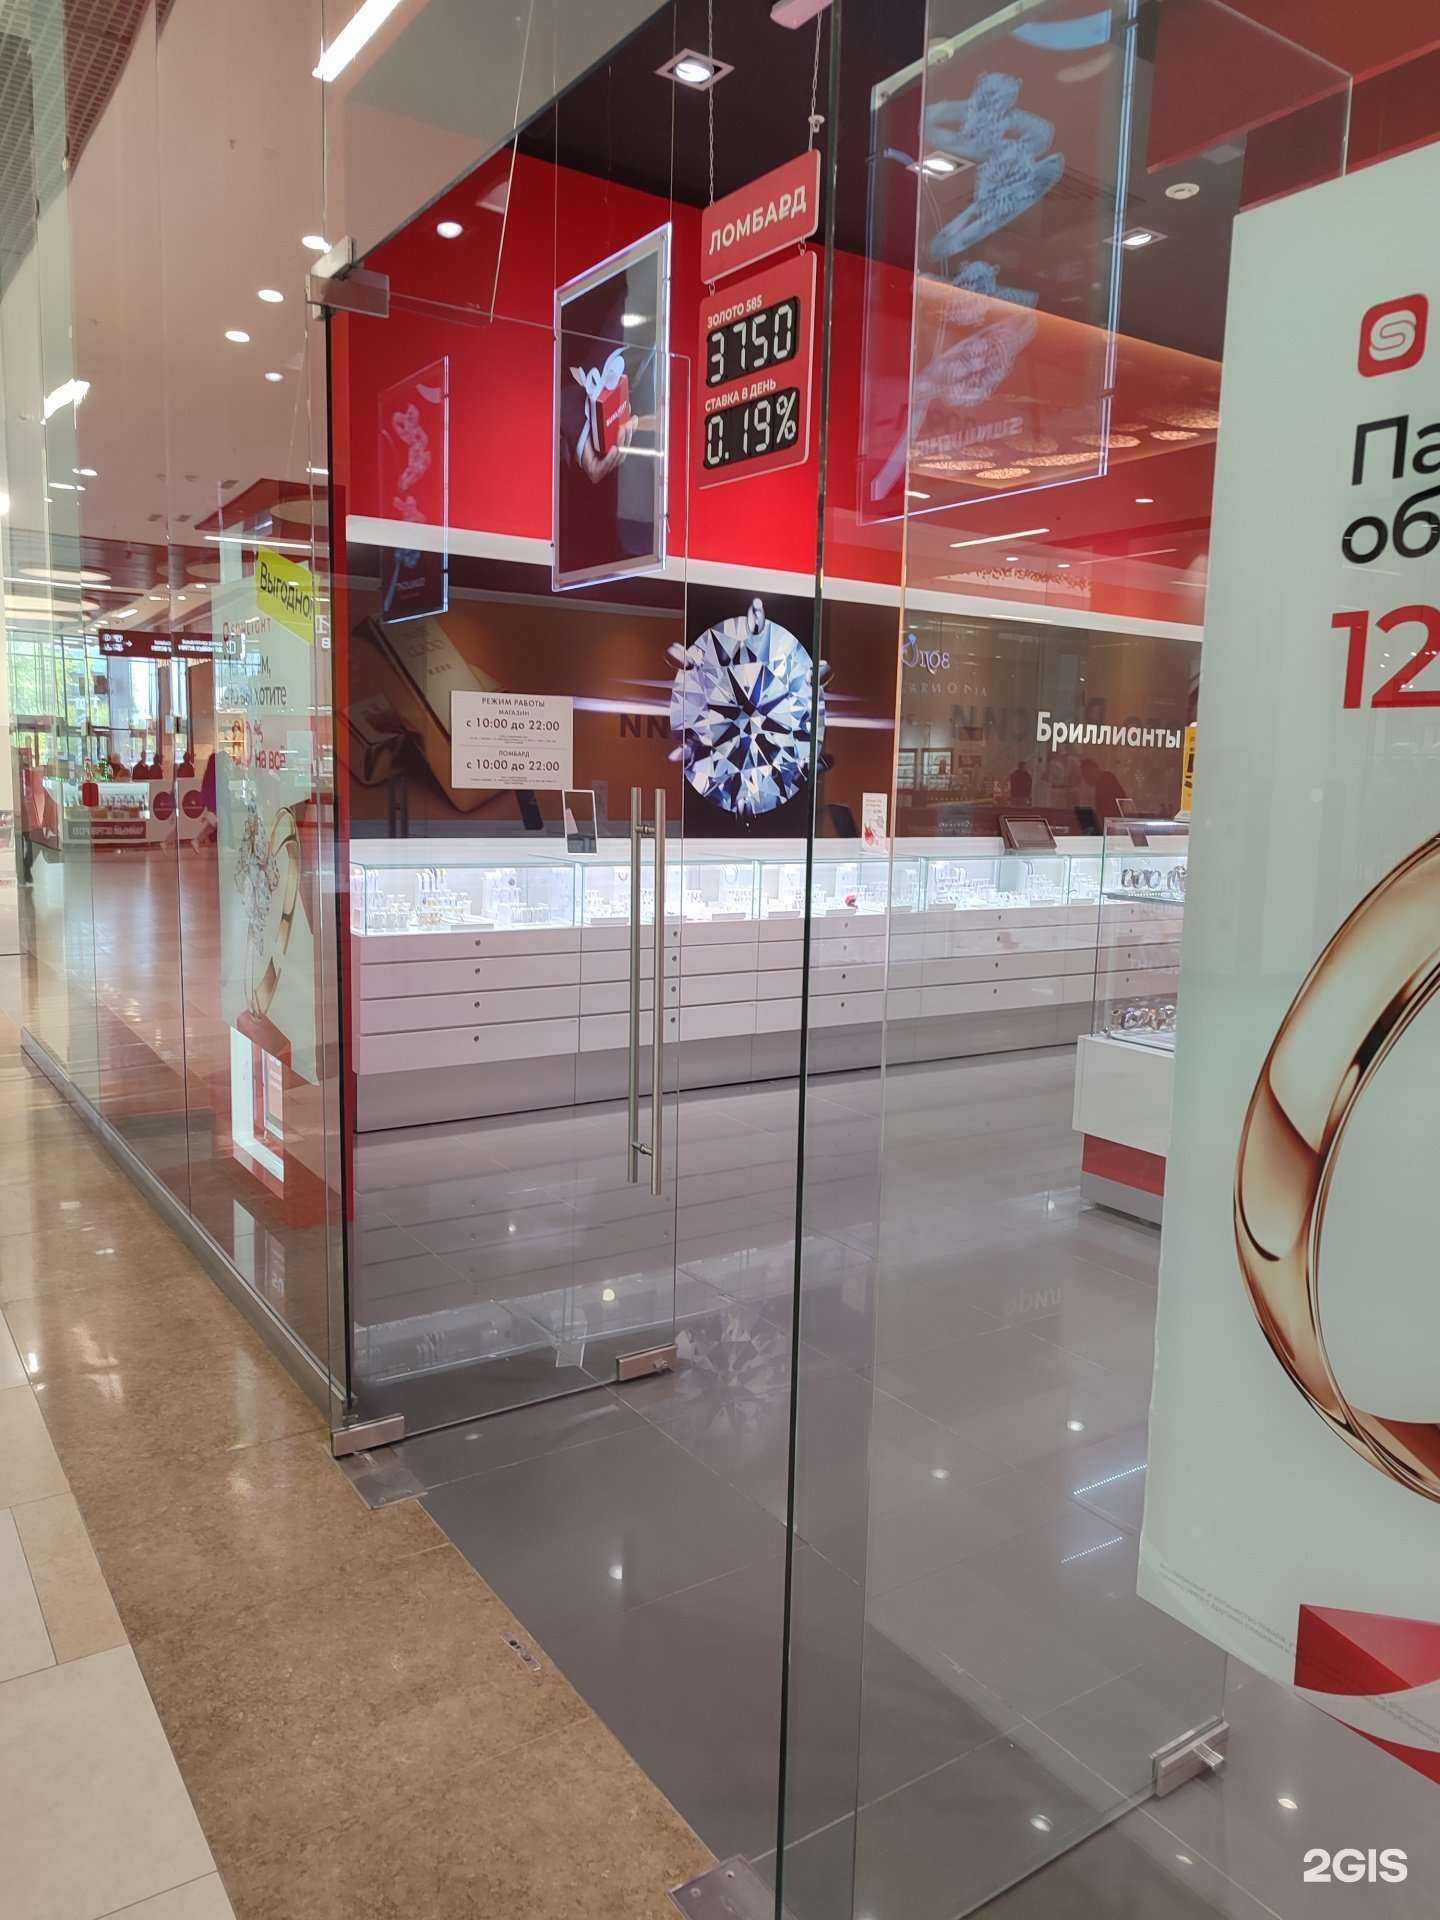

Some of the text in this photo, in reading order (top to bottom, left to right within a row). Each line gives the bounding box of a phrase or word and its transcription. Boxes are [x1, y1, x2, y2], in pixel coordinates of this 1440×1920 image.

[708, 184, 807, 256] ЛОМБАРД
[707, 295, 763, 329] ЗОЛОТО 585
[710, 304, 793, 384] 3750
[705, 379, 777, 413] СТАВКА В ДЕНЬ
[707, 392, 797, 465] 0.19%
[1330, 604, 1440, 709] 12
[254, 686, 287, 706] хотите
[482, 697, 545, 708] РЕЖИМ РАБОТЫ
[498, 709, 530, 717] МАГАЗИН
[466, 718, 560, 731] с 10:00 до 22:00
[1036, 711, 1181, 751] Бриллианты
[466, 759, 560, 772] с 10:00 до 22:00
[498, 750, 530, 758] ЛОМБАРД
